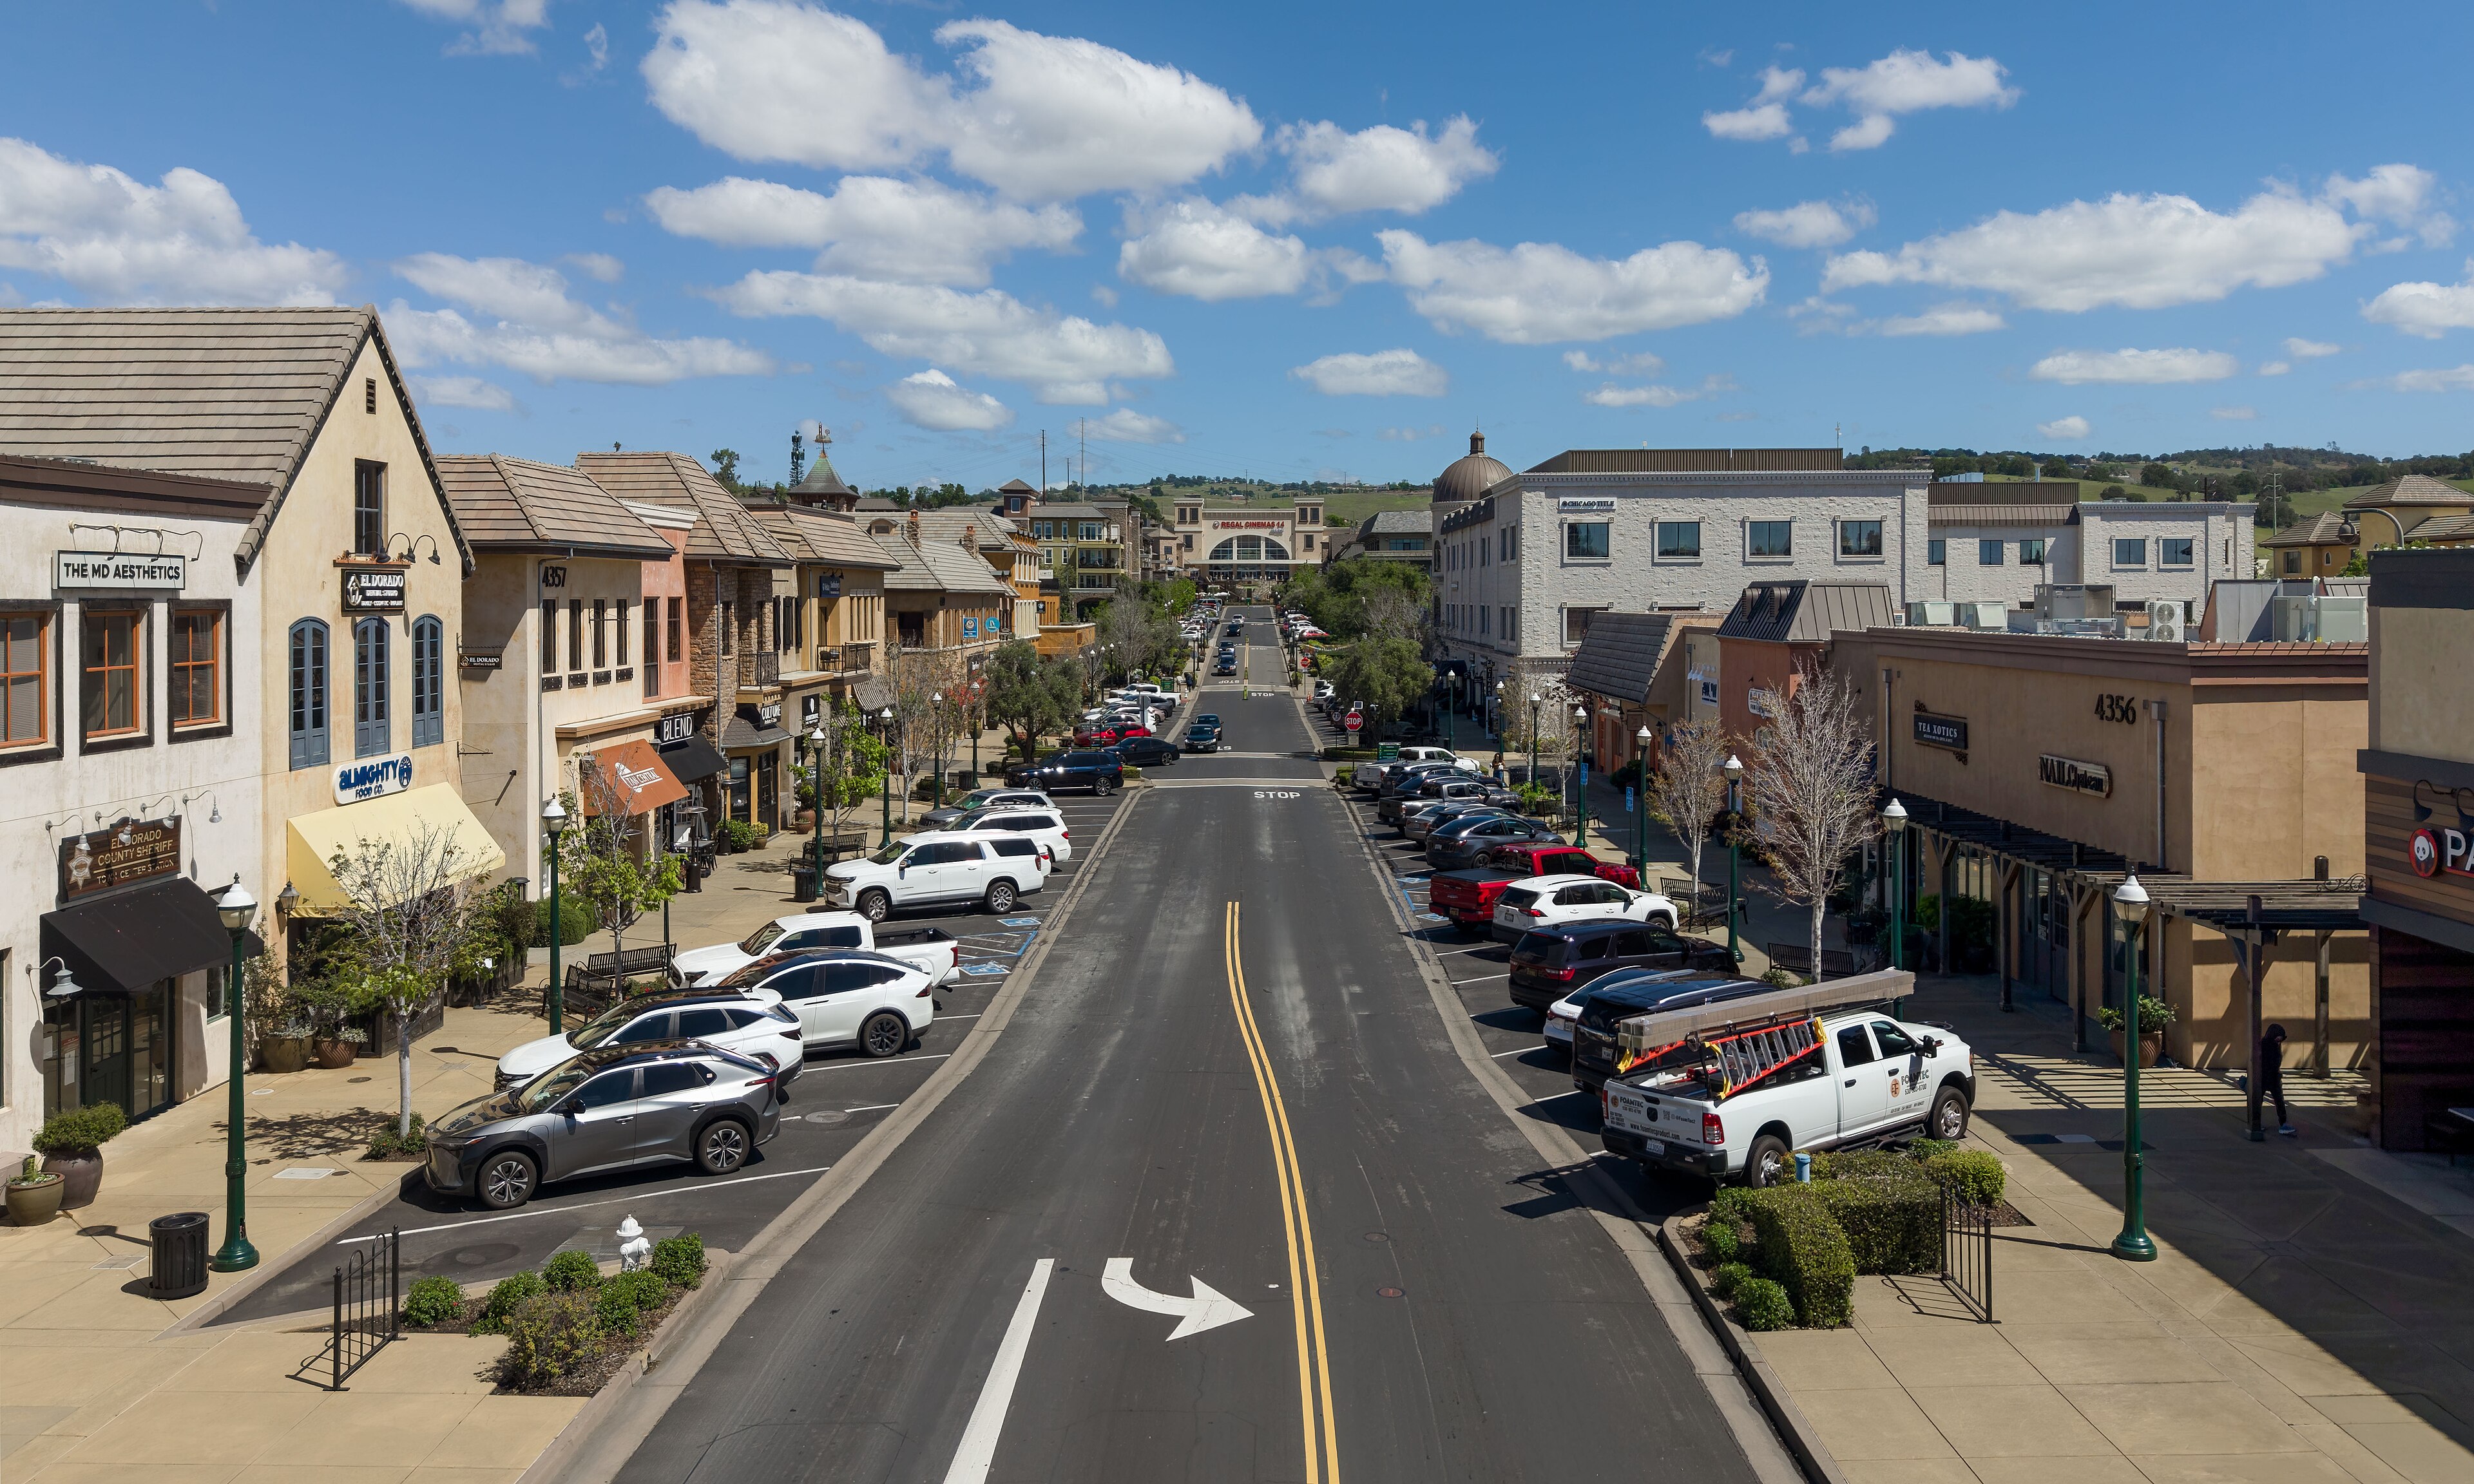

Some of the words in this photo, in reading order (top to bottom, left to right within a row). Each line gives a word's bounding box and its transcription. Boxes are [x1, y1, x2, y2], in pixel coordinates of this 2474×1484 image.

[64, 562, 88, 578] THE
[91, 564, 110, 578] MD
[113, 564, 180, 580] AESTHETICS
[542, 566, 567, 587] 4357
[360, 575, 371, 586] EL
[371, 575, 404, 587] DORADO
[761, 704, 781, 720] CULTURE
[2094, 694, 2136, 725] 4356
[664, 716, 693, 741] BLEND
[1918, 722, 1930, 733] TEA
[1933, 725, 1958, 737] XOTICS
[625, 775, 640, 786] TAN
[636, 770, 660, 783] CENTRAL
[2039, 756, 2065, 786] NAIL
[356, 786, 372, 800] FOOD
[111, 837, 123, 849] EL
[126, 829, 162, 846] ORADO
[98, 848, 135, 866] COUNTY
[136, 839, 173, 858] SHERIFF
[120, 866, 146, 880] CETER
[1901, 1069, 1930, 1086] FOTEC
[1620, 1096, 1644, 1108] FOAMTEC
